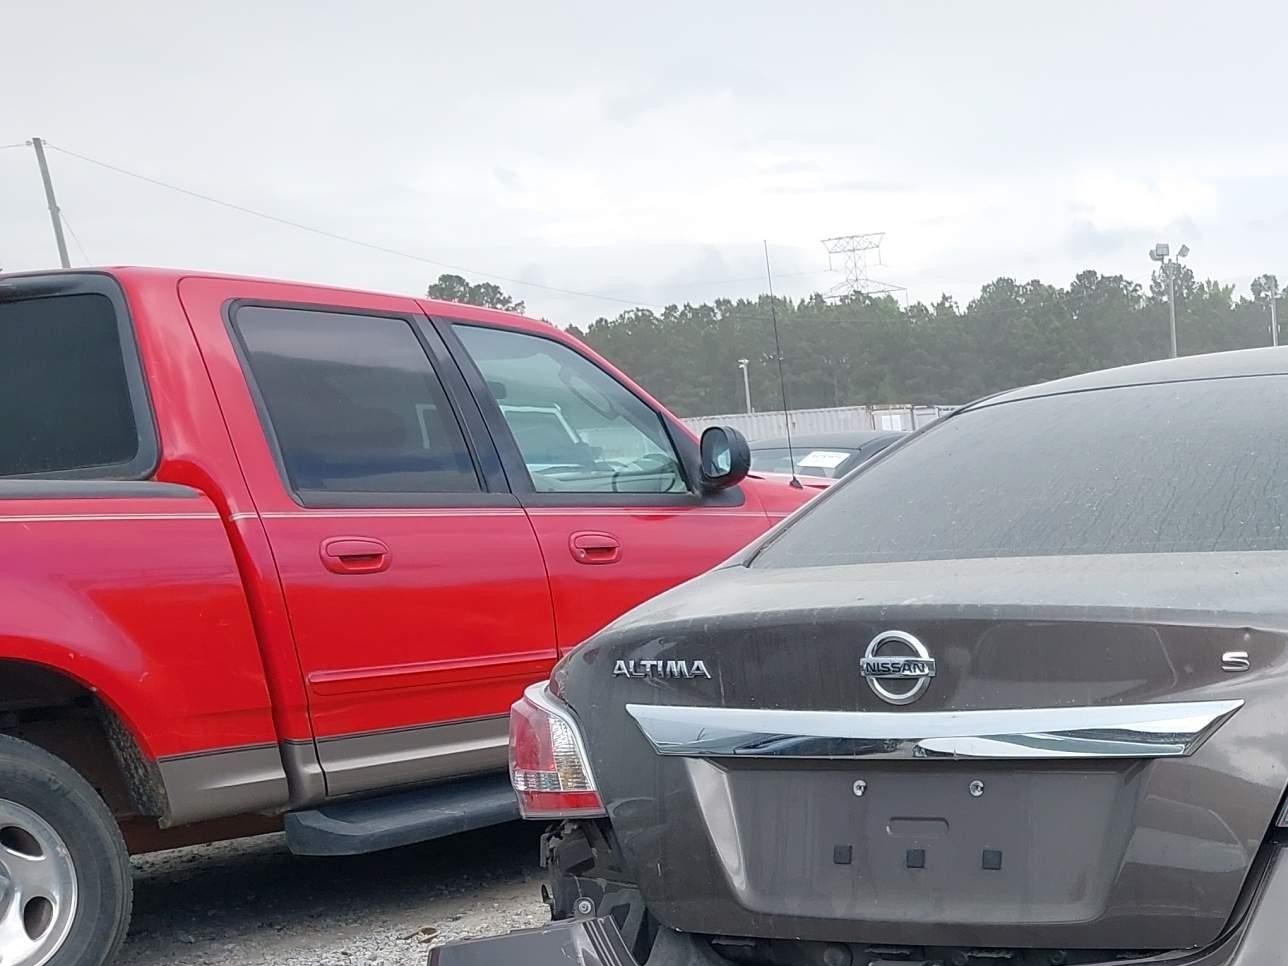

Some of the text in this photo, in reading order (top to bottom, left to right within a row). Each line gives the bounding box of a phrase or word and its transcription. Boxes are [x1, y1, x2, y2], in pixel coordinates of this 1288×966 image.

[611, 659, 712, 681] ALTIMA
[865, 661, 927, 675] NISSAN
[1221, 651, 1250, 673] S
